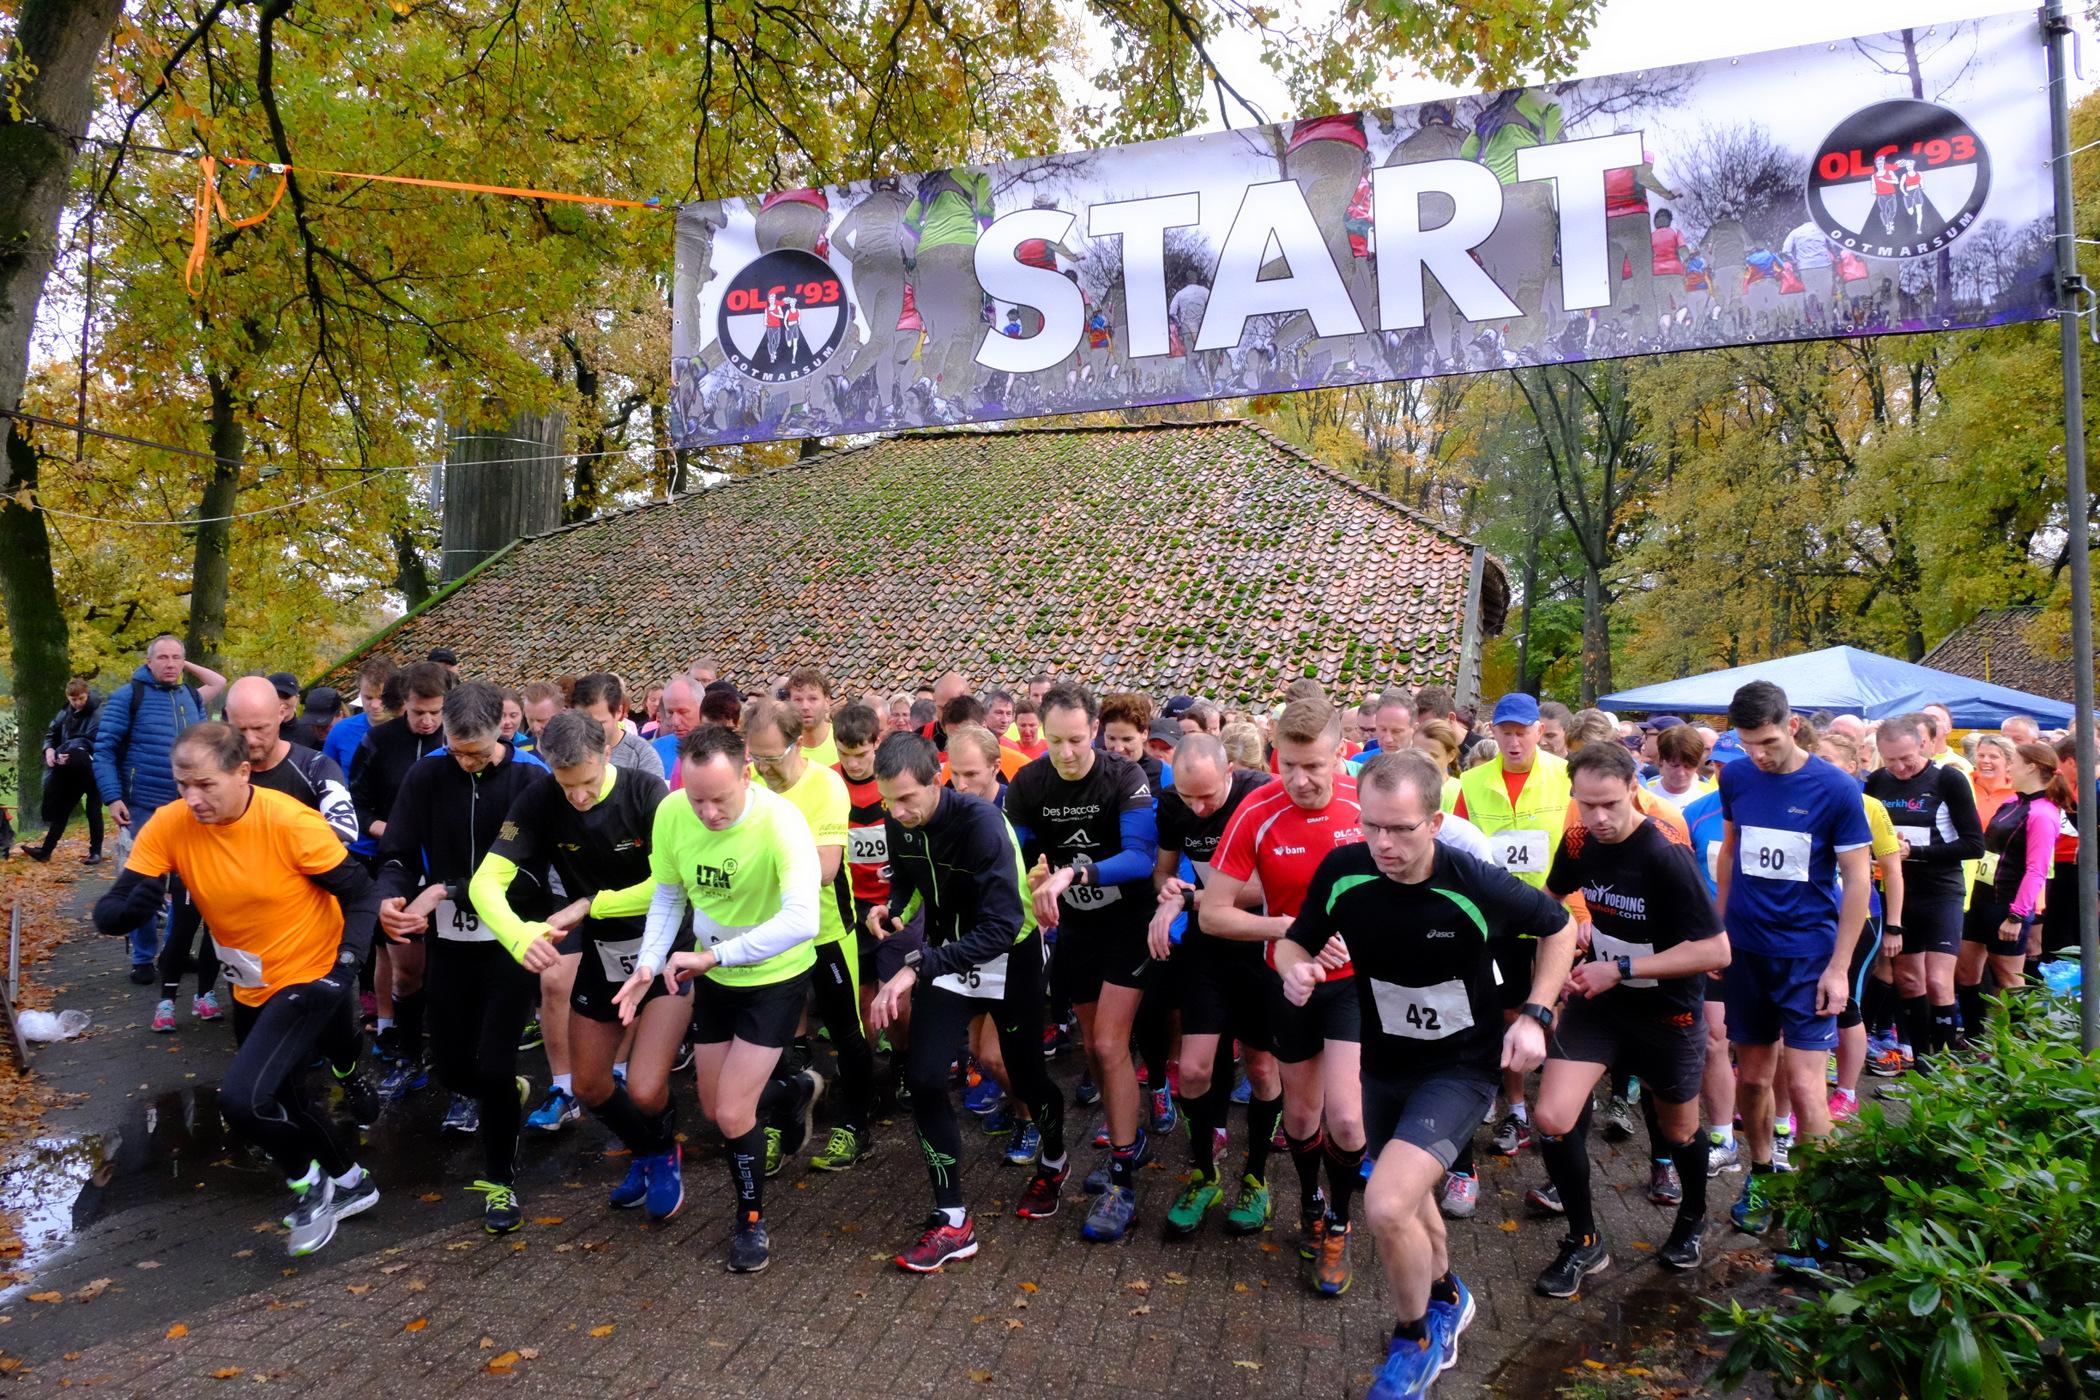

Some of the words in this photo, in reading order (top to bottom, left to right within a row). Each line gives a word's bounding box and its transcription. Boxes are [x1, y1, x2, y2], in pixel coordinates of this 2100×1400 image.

[1818, 144, 1898, 180] OLC
[1911, 134, 1977, 165] '93
[1830, 211, 1975, 257] OOTMARSUM
[973, 131, 1644, 374] START
[726, 285, 786, 312] OLC
[794, 279, 840, 305] '93
[730, 345, 835, 381] OOTMARSUM
[1042, 806, 1061, 817] Des
[854, 839, 887, 857] 229
[1185, 836, 1203, 848] Des
[1285, 845, 1306, 855] bam
[1506, 845, 1529, 865] 24
[1759, 847, 1785, 871] 80
[1068, 886, 1104, 904] 186
[1604, 892, 1646, 914] VOEDING
[452, 908, 479, 932] 45
[1406, 1003, 1441, 1031] 42
